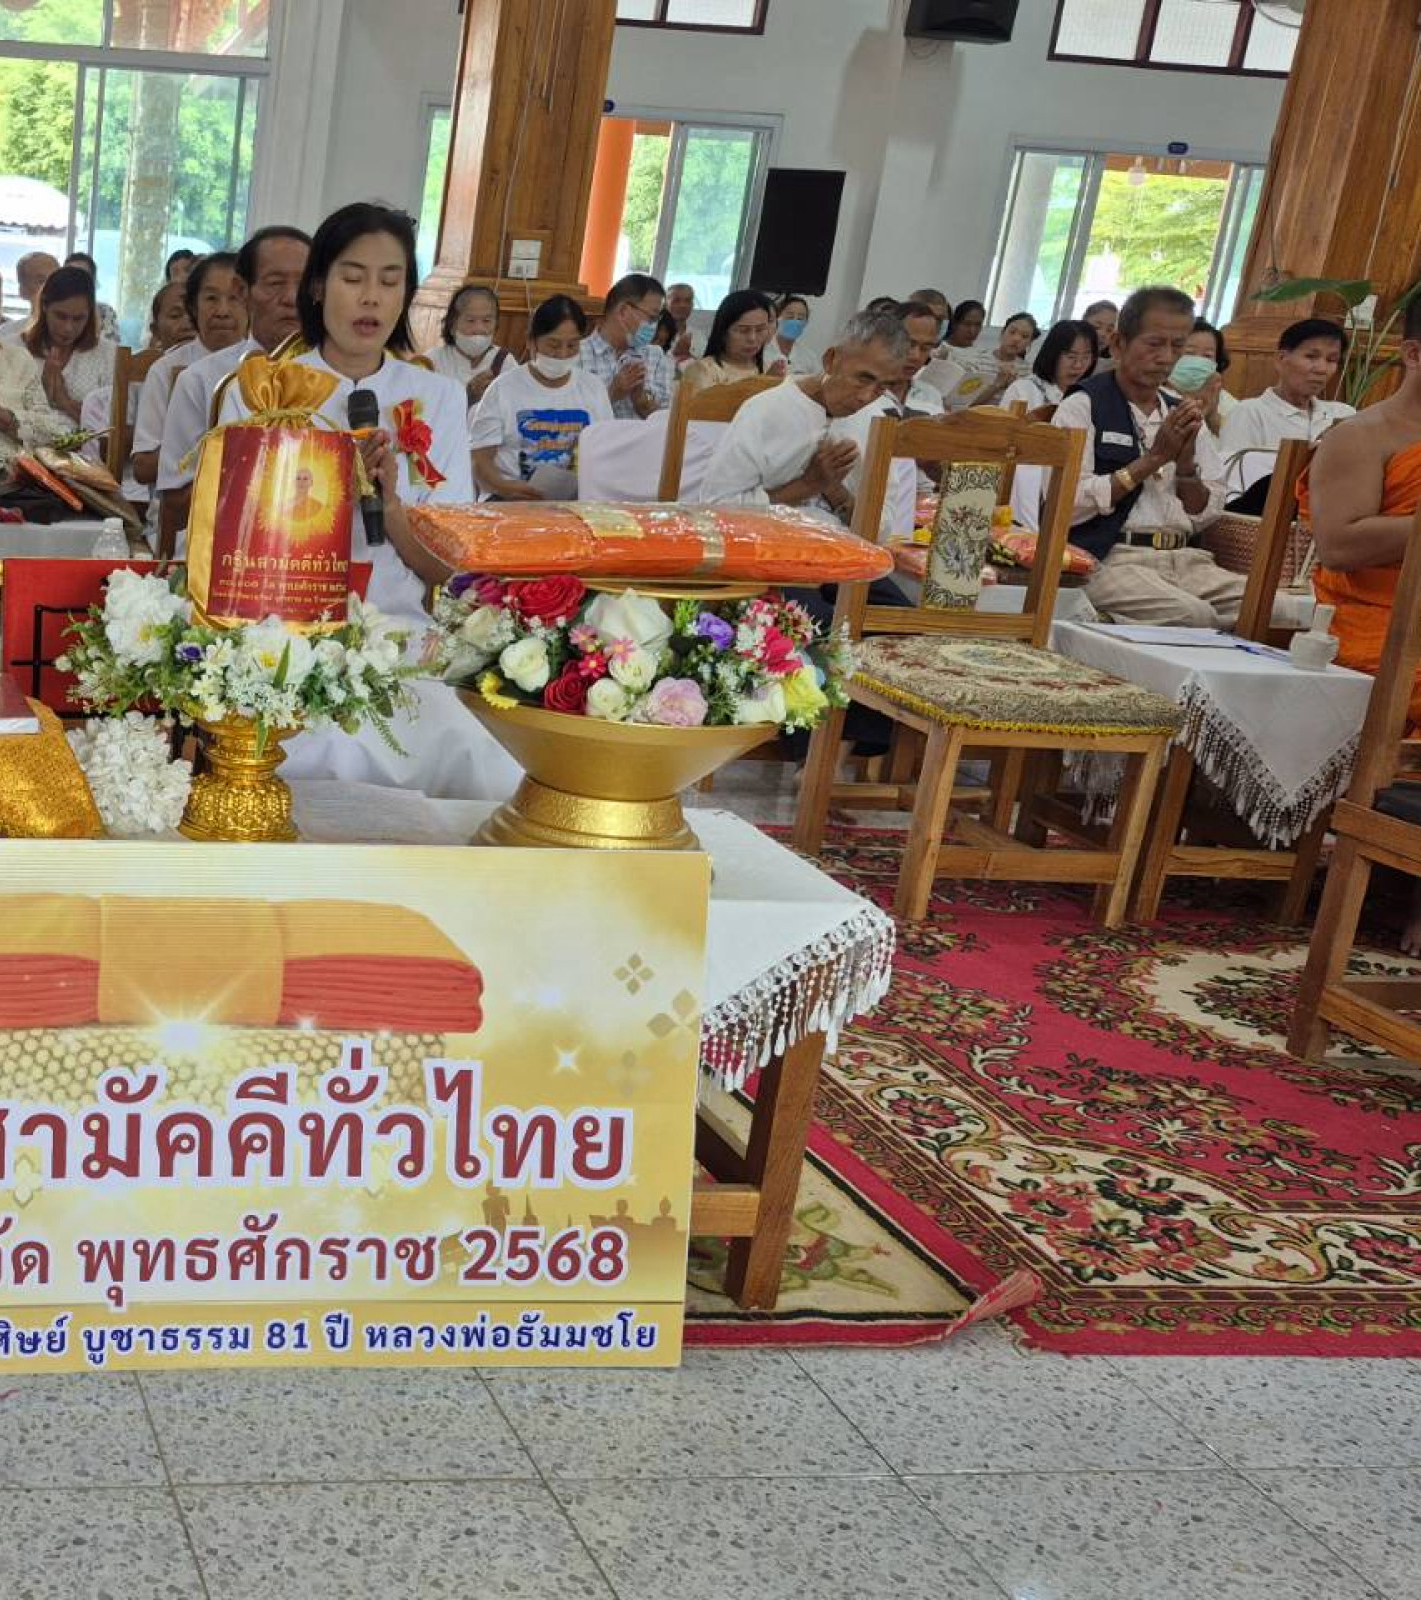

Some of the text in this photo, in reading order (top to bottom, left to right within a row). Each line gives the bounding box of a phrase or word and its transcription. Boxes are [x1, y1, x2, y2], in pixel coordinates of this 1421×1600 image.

[77, 1212, 438, 1307] พุทธศักราช
[462, 1229, 625, 1282] 2568
[82, 1326, 249, 1365] บูชาธรรม
[266, 1322, 308, 1350] 81
[325, 1312, 350, 1350] ปี
[365, 1311, 657, 1349] หลวงพ่อธัมมชโย
